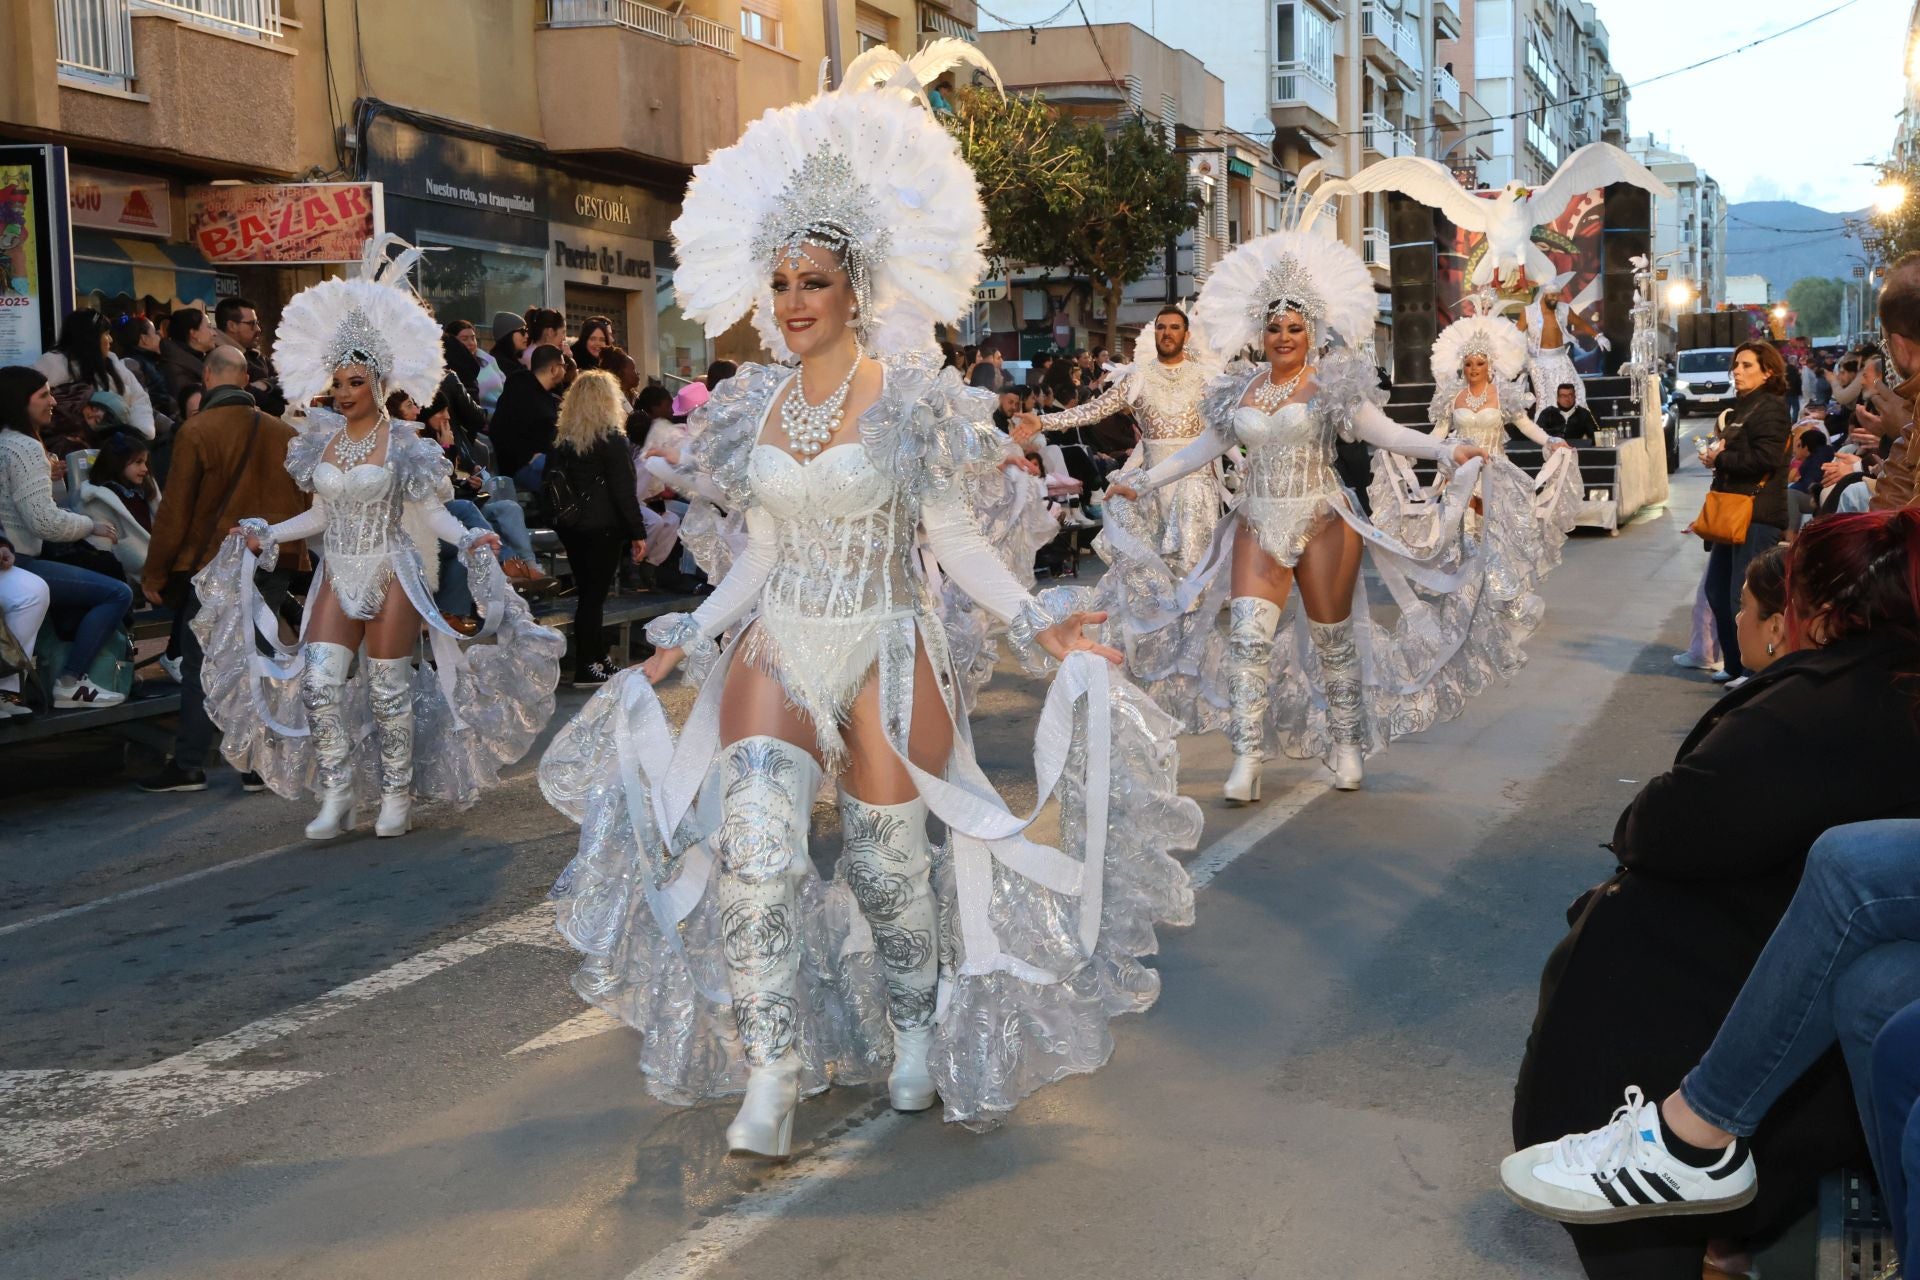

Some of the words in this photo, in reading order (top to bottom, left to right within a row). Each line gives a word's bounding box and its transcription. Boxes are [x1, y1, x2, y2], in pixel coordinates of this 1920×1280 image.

[425, 178, 458, 198] Nuestro
[460, 187, 478, 206] reto,
[478, 192, 488, 204] su
[489, 192, 535, 212] tranquilidad
[575, 194, 632, 225] GESTORÍA
[199, 186, 367, 257] BAZAR
[555, 240, 597, 271] Puerta
[600, 247, 614, 273] de
[616, 250, 651, 279] Lorca
[0, 297, 29, 307] 2025
[1662, 1172, 1681, 1191] SAMBA
